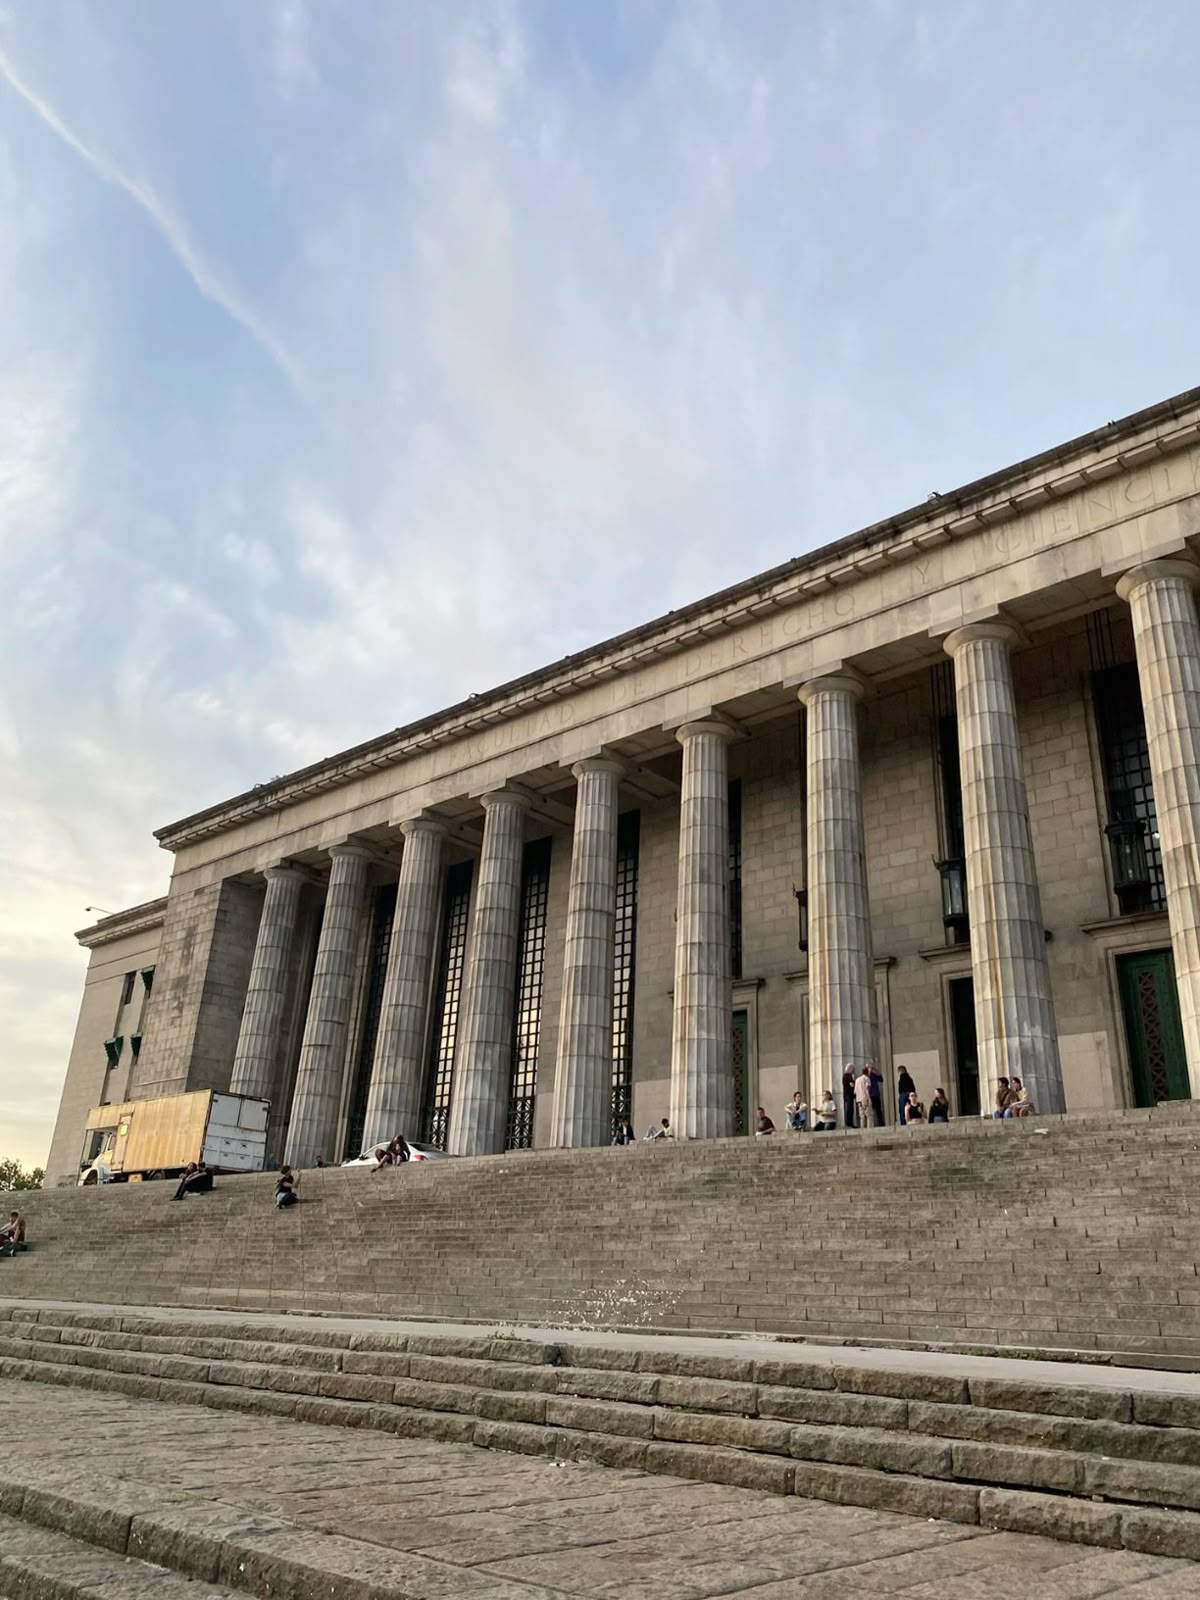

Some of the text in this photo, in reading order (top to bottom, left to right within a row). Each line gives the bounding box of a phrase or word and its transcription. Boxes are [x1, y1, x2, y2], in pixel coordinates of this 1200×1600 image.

[613, 679, 648, 705] DE
[685, 594, 856, 676] DERECHO
[915, 560, 931, 585] Y
